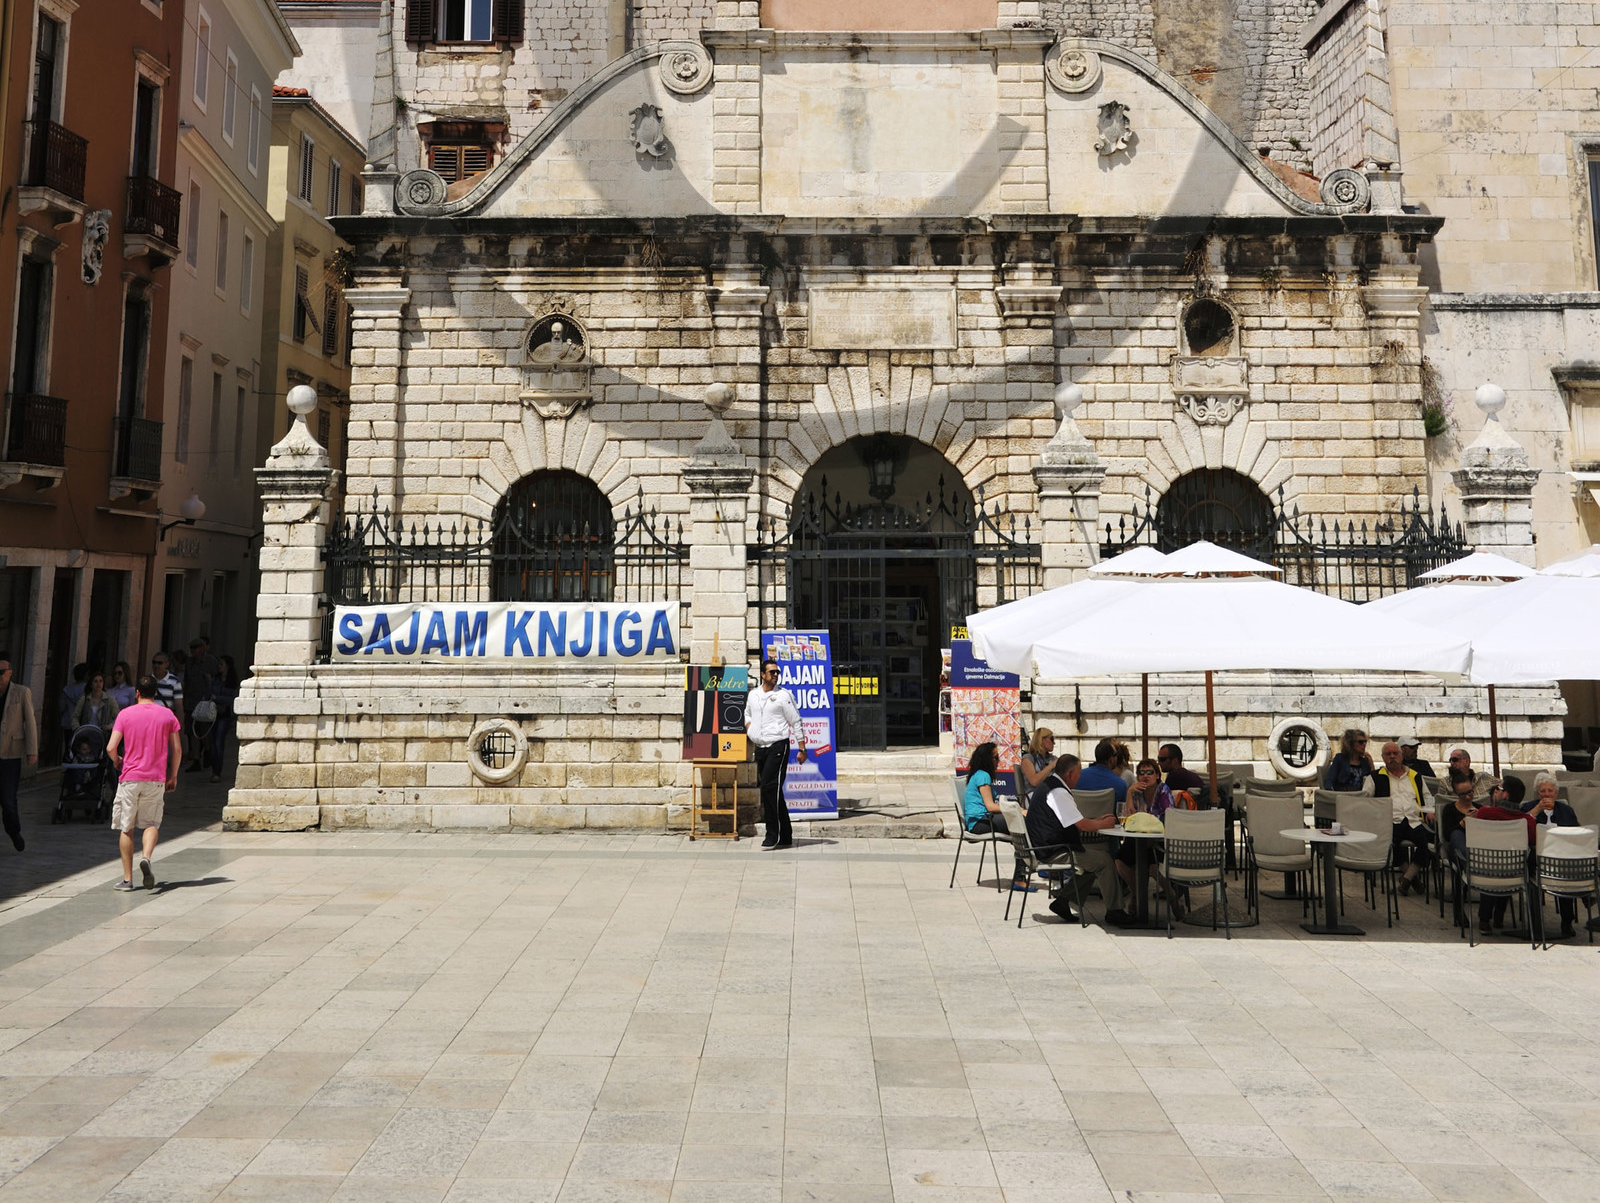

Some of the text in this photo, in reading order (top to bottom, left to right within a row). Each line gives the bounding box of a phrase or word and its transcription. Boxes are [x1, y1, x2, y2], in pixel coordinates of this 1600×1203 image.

[336, 609, 677, 658] SAJAM KNJIGA
[704, 675, 745, 690] Bistro
[788, 688, 831, 710] JIGA
